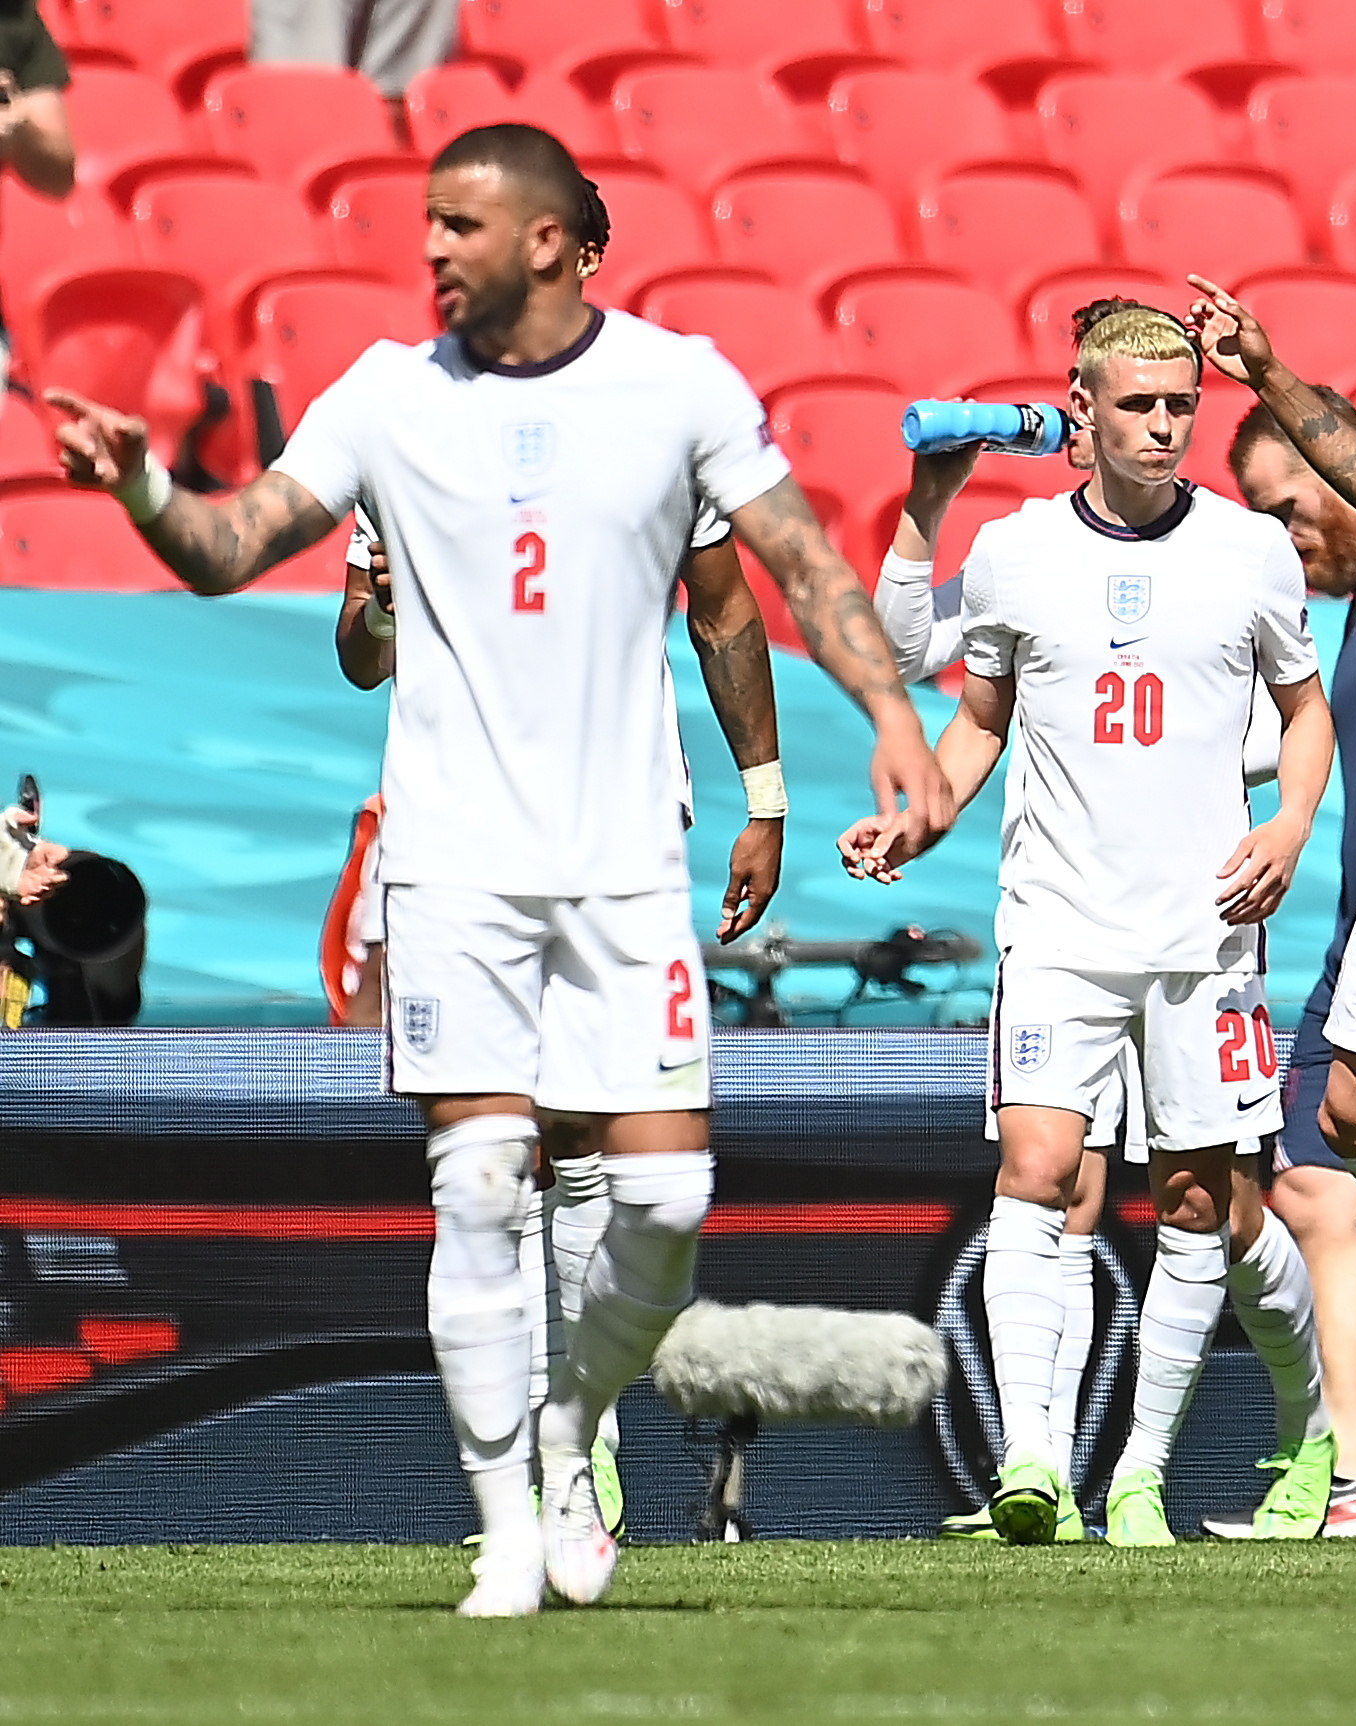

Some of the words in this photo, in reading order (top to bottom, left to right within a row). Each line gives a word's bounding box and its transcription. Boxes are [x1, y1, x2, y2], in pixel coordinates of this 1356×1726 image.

[513, 530, 547, 614] 2
[1093, 671, 1164, 747] 20
[666, 959, 695, 1041] 2
[1215, 1004, 1278, 1083] 20
